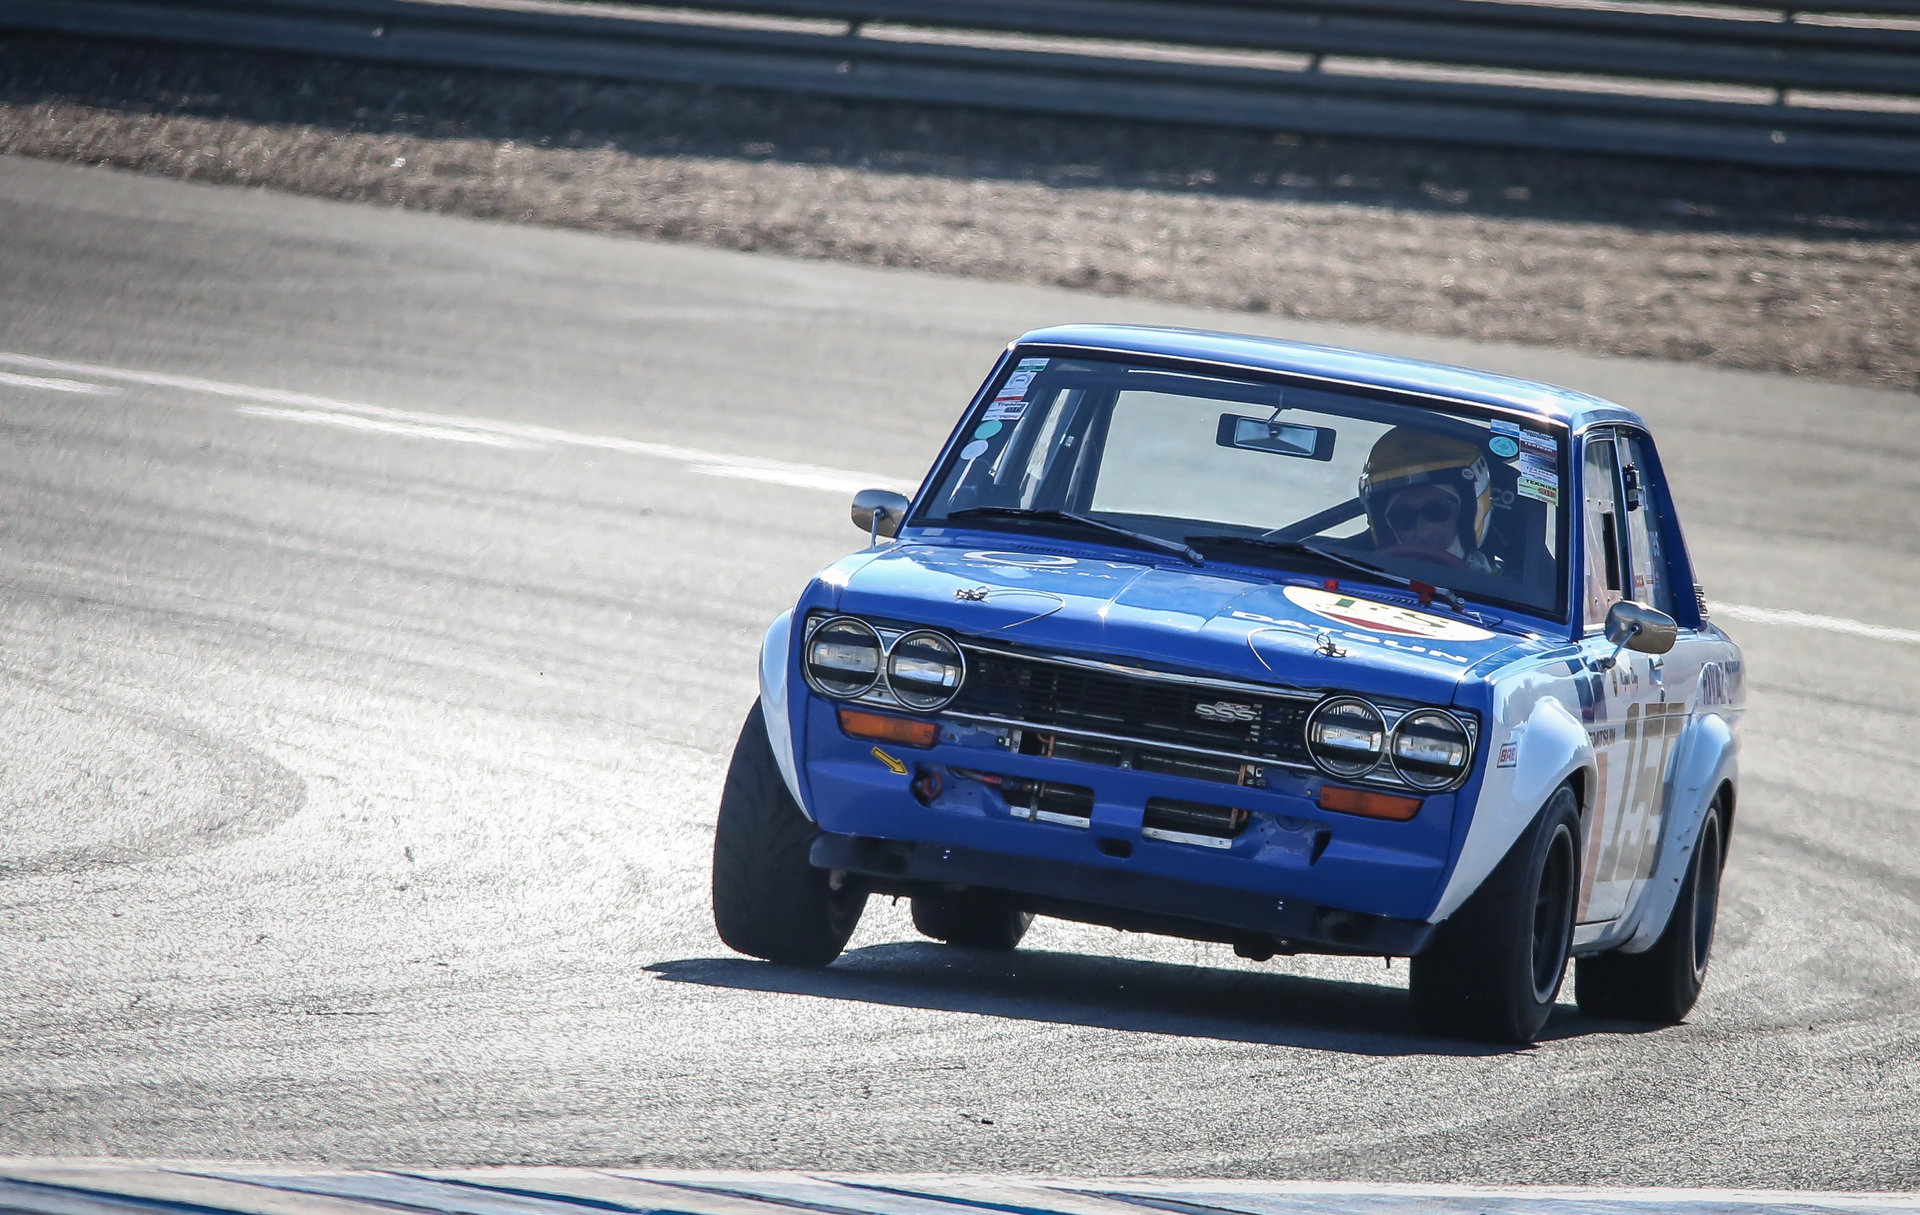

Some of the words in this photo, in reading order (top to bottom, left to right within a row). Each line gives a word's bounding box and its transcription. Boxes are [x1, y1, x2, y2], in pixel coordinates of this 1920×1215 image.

[1525, 478, 1557, 492] TEKNISK
[1231, 610, 1468, 664] DATSUN
[1194, 703, 1258, 721] SSS
[1499, 748, 1516, 762] BRE
[1596, 702, 1686, 882] 15
